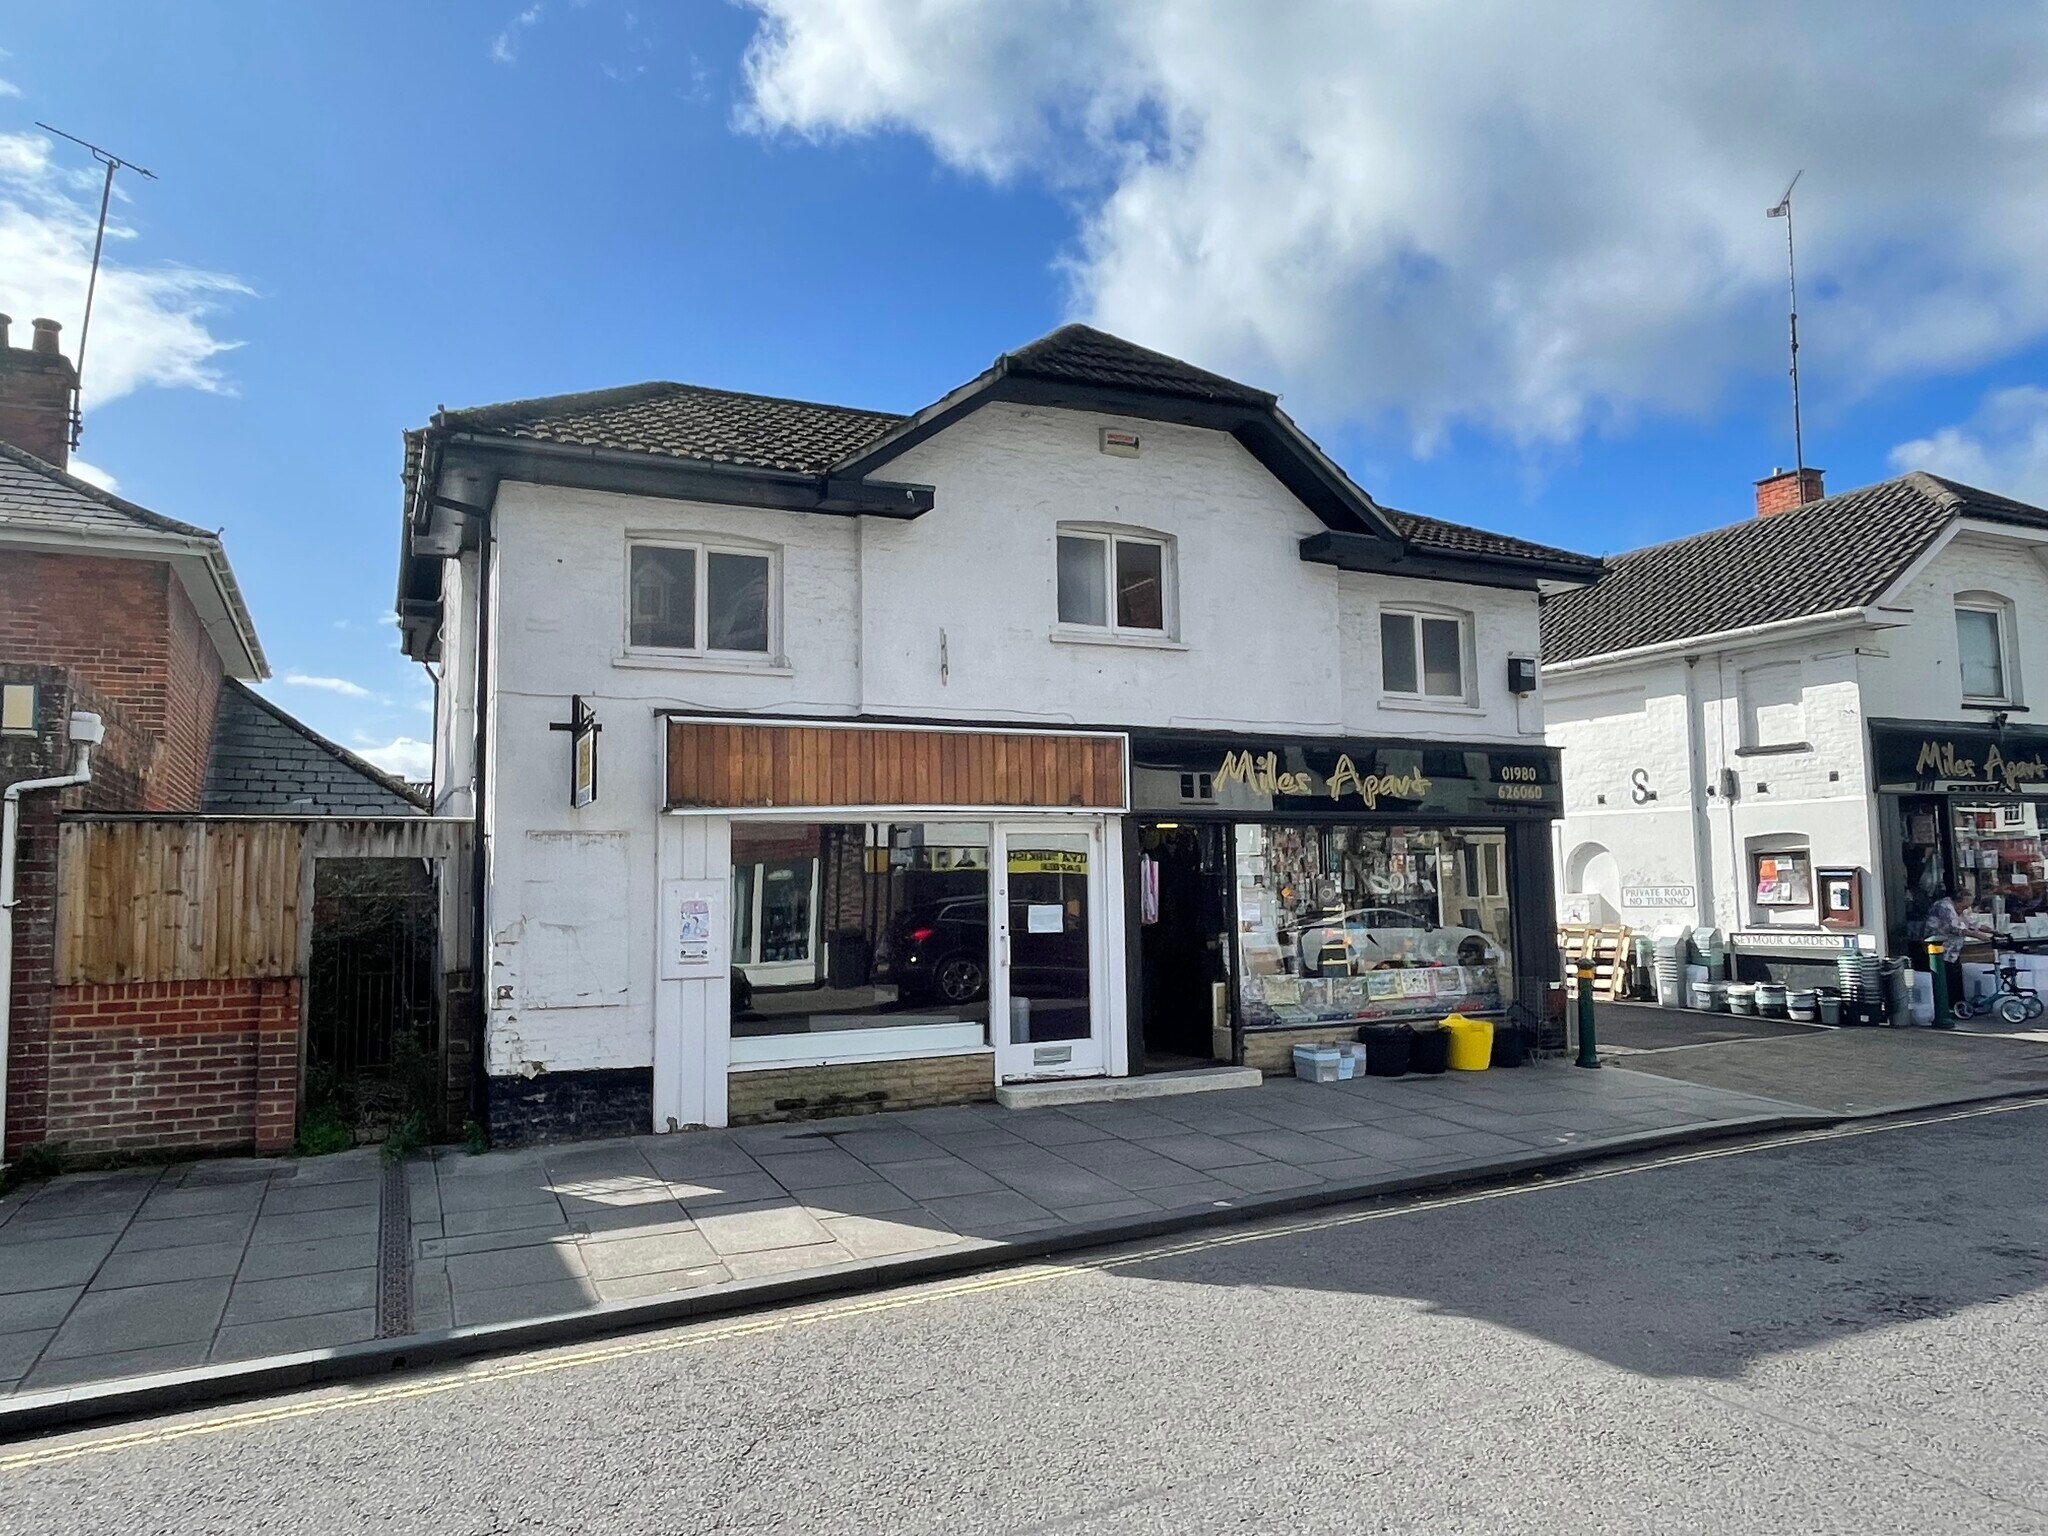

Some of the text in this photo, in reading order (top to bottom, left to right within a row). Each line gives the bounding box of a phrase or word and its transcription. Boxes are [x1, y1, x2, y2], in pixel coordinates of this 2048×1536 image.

[1916, 741, 1976, 777] Miles
[1213, 750, 1432, 810] Miles Apart
[1501, 766, 1536, 781] 01980
[1498, 785, 1542, 800] 626060
[1625, 888, 1690, 897] PRIVATE ROAD
[1629, 897, 1688, 906] NO TURNING
[1733, 935, 1840, 946] SEYMOUR GARDENS
